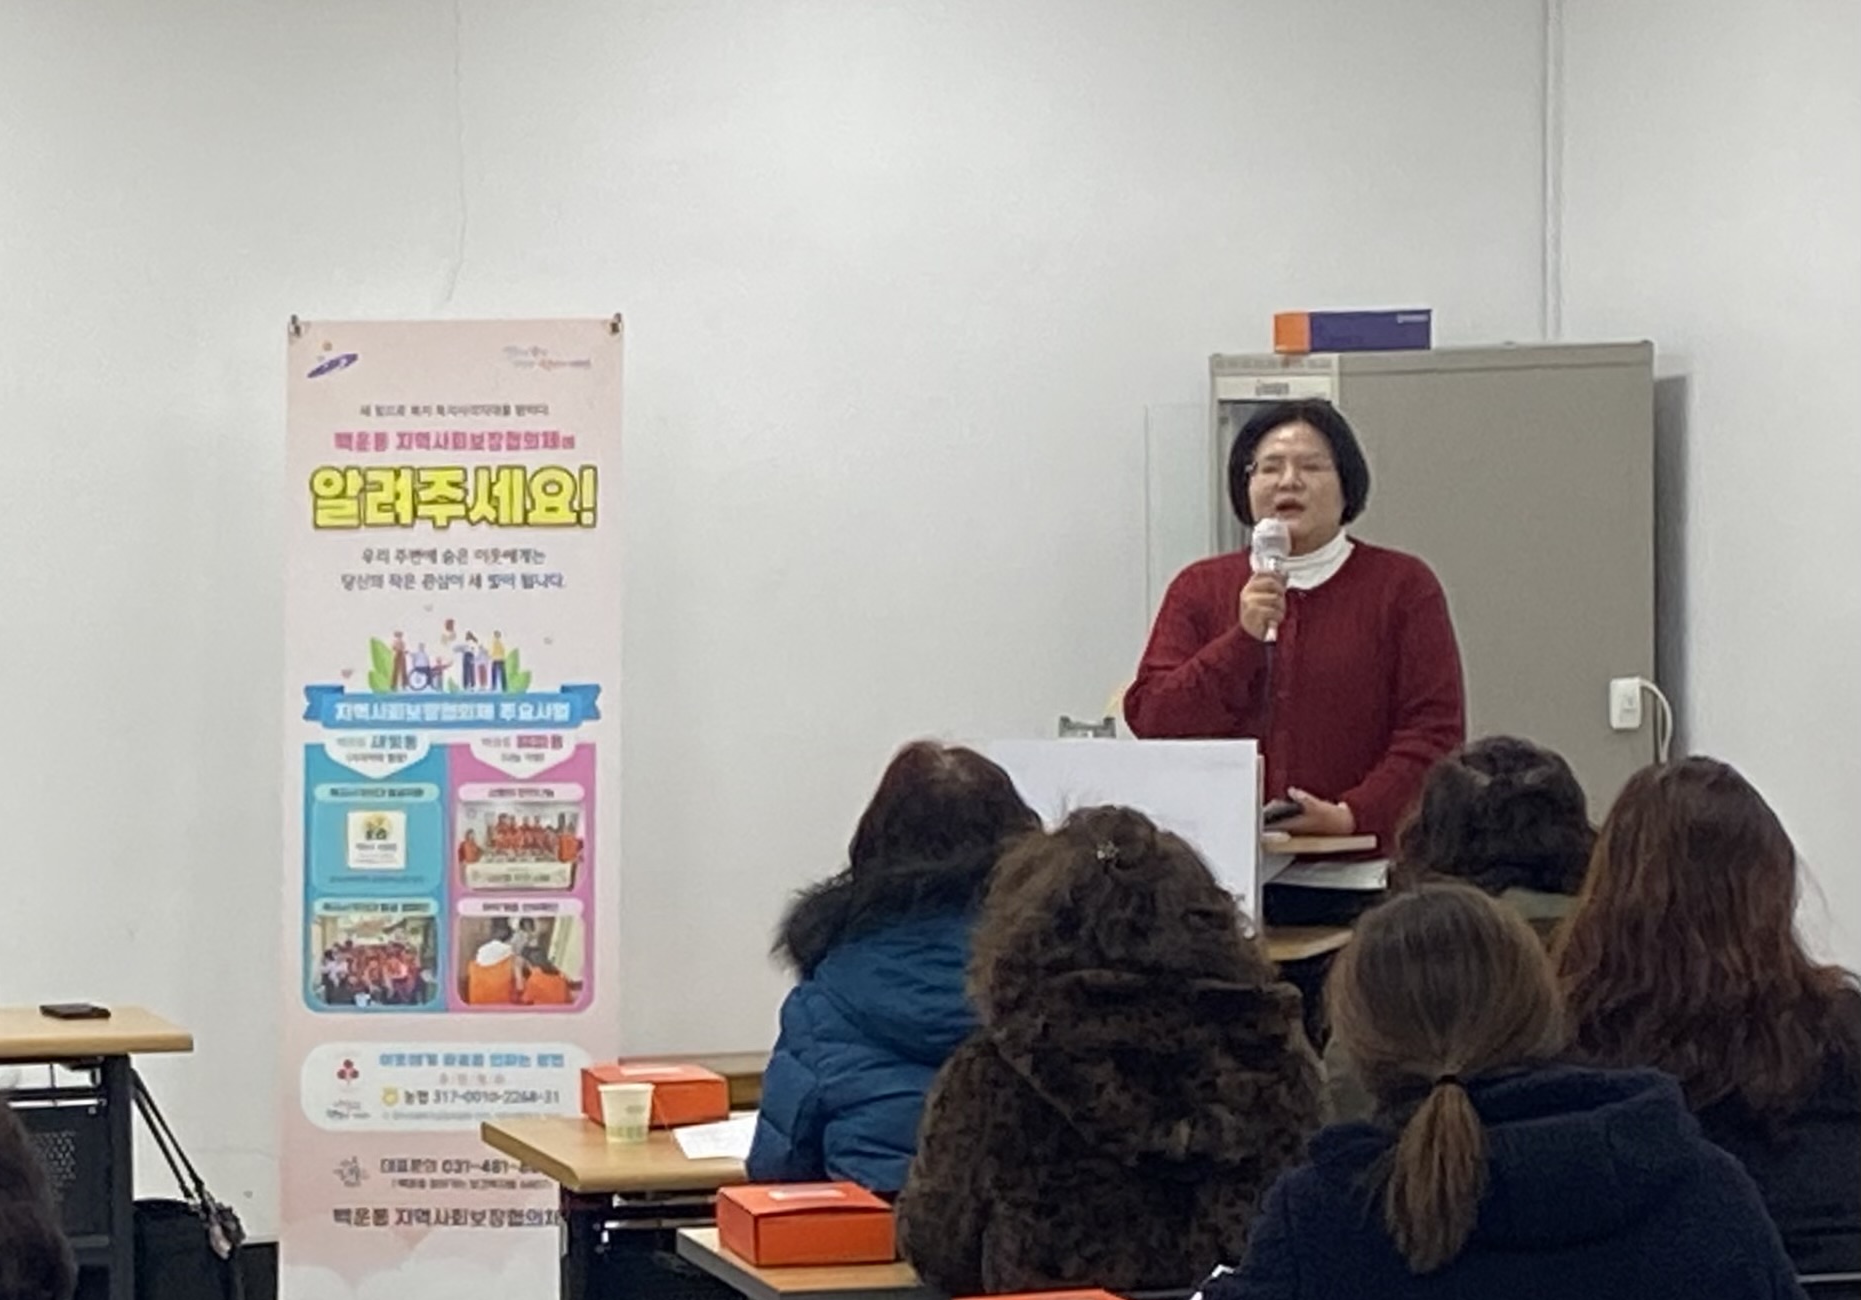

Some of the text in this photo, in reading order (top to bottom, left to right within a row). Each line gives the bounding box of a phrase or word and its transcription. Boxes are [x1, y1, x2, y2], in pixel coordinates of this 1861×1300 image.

[334, 431, 388, 451] 백운동
[309, 464, 598, 529] 알려주세요!
[362, 549, 390, 565] 우리
[395, 549, 437, 565] 주변에
[341, 573, 384, 590] 당신의
[421, 573, 465, 590] 관심이
[335, 702, 570, 722] 지역사회보장협의체 주요사업
[333, 1208, 389, 1227] 백운동
